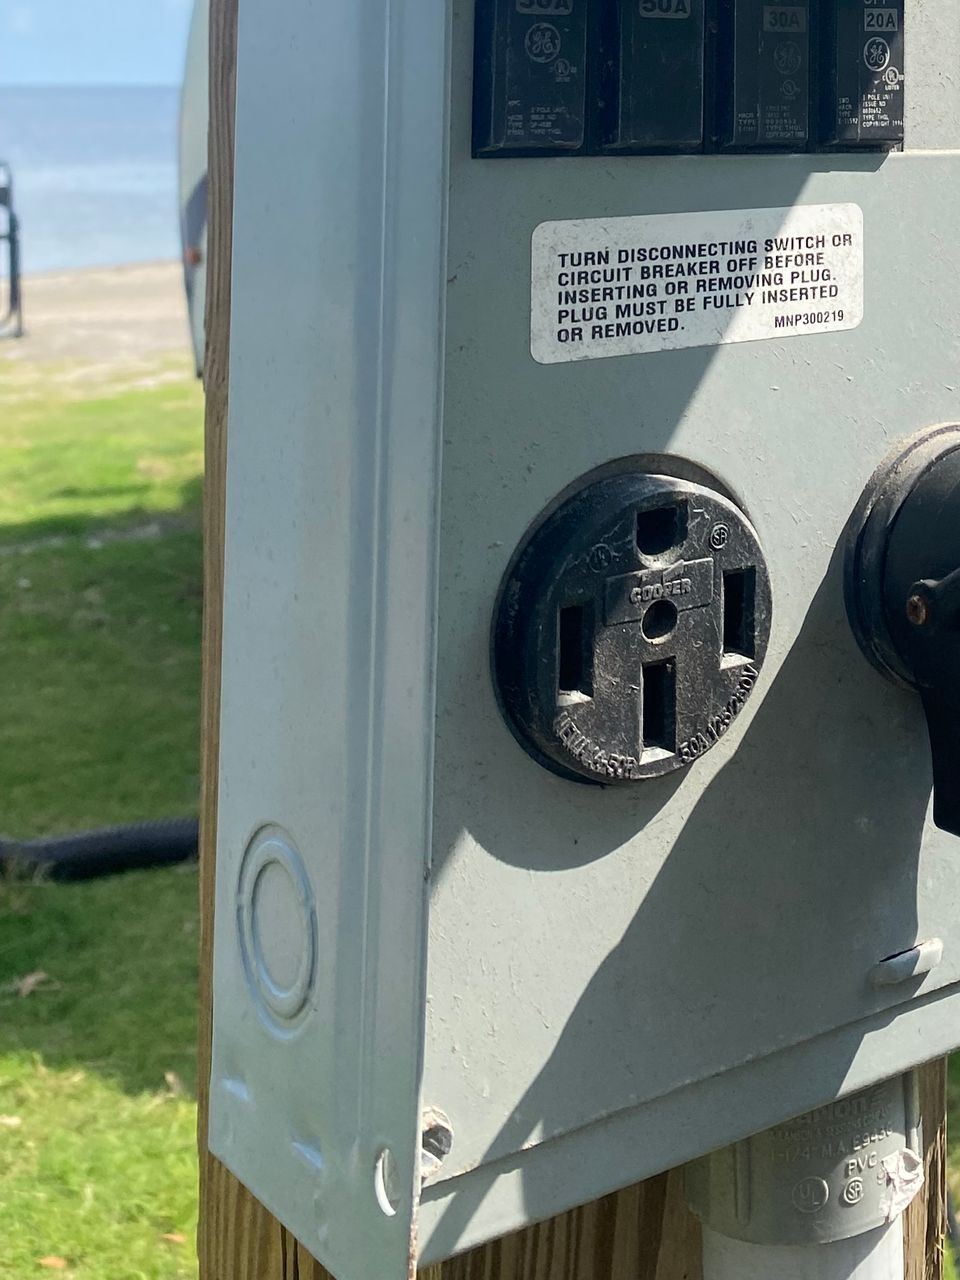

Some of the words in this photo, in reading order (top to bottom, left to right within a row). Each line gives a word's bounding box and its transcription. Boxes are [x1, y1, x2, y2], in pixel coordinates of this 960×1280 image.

[769, 10, 799, 28] 30A
[866, 13, 896, 28] 20A
[557, 250, 609, 268] TURN
[618, 240, 757, 264] DISCONNECTING
[764, 235, 825, 253] SWITCH
[832, 233, 852, 247] OR
[558, 267, 633, 286] CIRCUIT
[640, 260, 720, 280] BREAKER
[727, 257, 757, 272] OFF
[764, 252, 824, 269] BEFORE
[558, 283, 657, 305] INSERTING
[665, 281, 688, 295] OR
[696, 273, 783, 293] REMOVING
[791, 268, 836, 284] PLUG.
[558, 306, 607, 324] PLUG
[615, 300, 667, 319] MUST
[675, 297, 696, 313] BE
[703, 292, 754, 310] FULLY
[762, 285, 838, 304] INSERTED
[557, 327, 583, 343] OR
[591, 318, 685, 340] REMOVED.
[774, 309, 844, 328] MNP300219
[630, 579, 691, 604] COOPER
[848, 1152, 877, 1176] PVC
